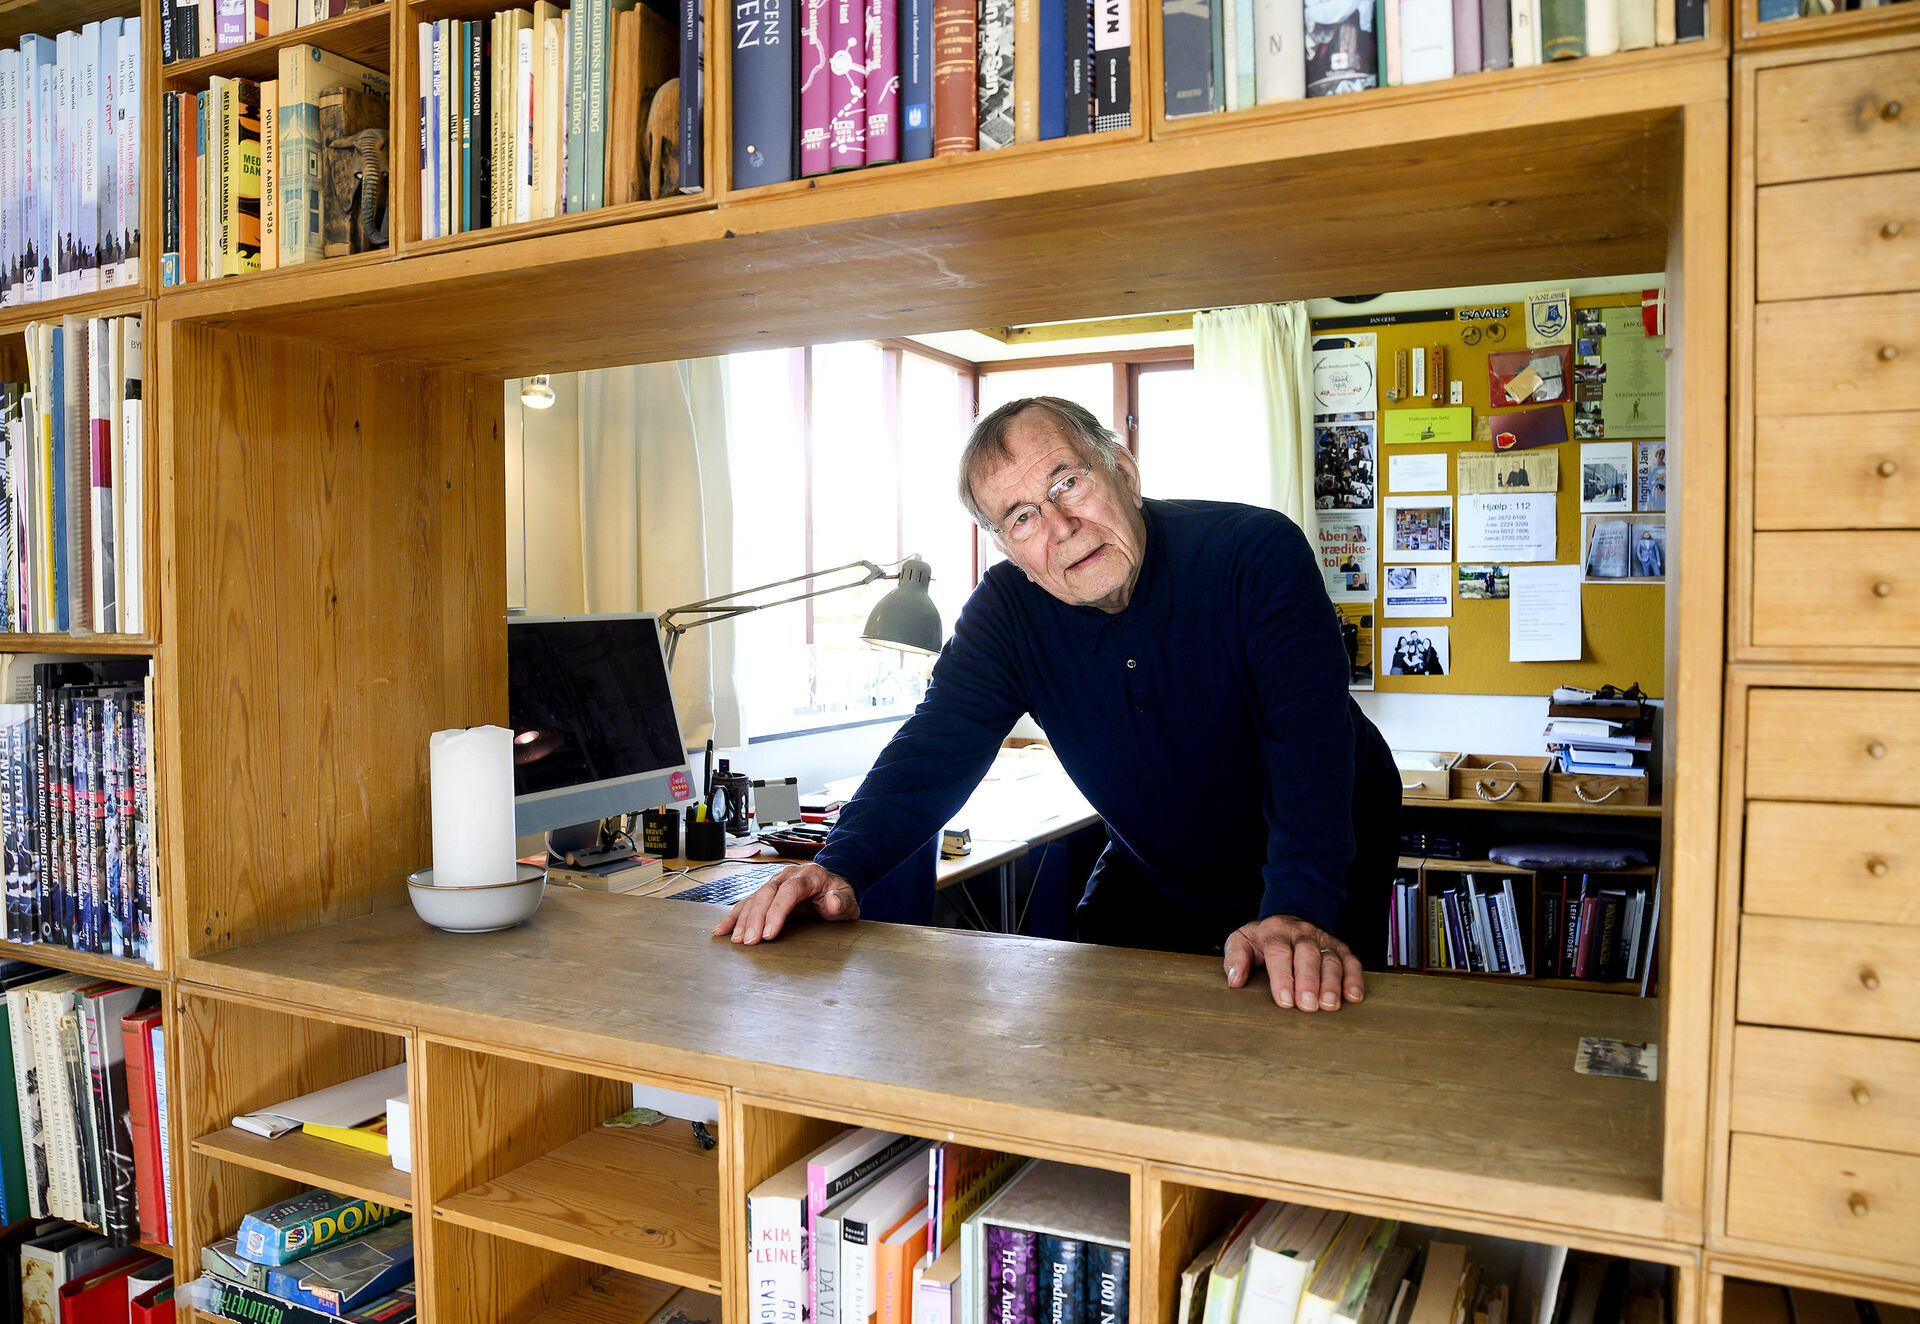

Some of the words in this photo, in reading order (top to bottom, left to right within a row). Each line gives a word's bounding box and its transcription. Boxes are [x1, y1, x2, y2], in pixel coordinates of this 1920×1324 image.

[839, 4, 849, 24] land
[219, 33, 244, 44] Brown
[224, 22, 239, 33] Dan
[128, 53, 136, 69] Jan
[520, 42, 529, 64] art
[86, 63, 94, 78] Jan
[128, 69, 136, 93] Gehl
[984, 55, 1003, 96] Sun
[86, 80, 94, 97] Gel
[223, 91, 231, 111] MED
[571, 74, 583, 135] BILLEDBOG
[590, 71, 601, 133] BILLEDBOG
[85, 118, 94, 155] Gradovi
[222, 113, 230, 173] ARKÆOLOGEN
[86, 157, 93, 167] za
[243, 153, 261, 166] MED
[85, 168, 94, 192] ljude
[127, 162, 135, 196] Kentler
[222, 175, 230, 222] DANMARK
[221, 225, 229, 256] RUNDT
[1458, 307, 1509, 321] SAAB
[1638, 449, 1649, 465] Jan
[1639, 475, 1651, 503] Ingrid
[1482, 503, 1508, 513] Hjælp
[1515, 502, 1531, 510] 112
[12, 726, 21, 761] NEW
[13, 765, 23, 798] CITY
[38, 774, 45, 788] NA
[49, 782, 57, 801] HOW
[2, 792, 11, 835] BYLIV
[14, 802, 23, 835] LIFE
[38, 789, 46, 826] CIDADE:
[50, 801, 57, 813] TO
[40, 826, 48, 854] COMO
[51, 839, 59, 865] PUBLIC
[41, 854, 49, 898] ESTUDAR
[91, 876, 99, 908] RUUMIS
[1569, 904, 1577, 920] LEIF
[1566, 921, 1576, 959] DAVIDSEN
[762, 1228, 791, 1242] KIM
[844, 1232, 865, 1242] Edition
[845, 1226, 864, 1236] Second
[756, 1247, 798, 1265] LEINE
[1002, 1250, 1016, 1285] H.C.
[819, 1268, 834, 1293] DA
[1101, 1272, 1118, 1307] 1001
[312, 1288, 335, 1301] MATCH
[318, 1299, 334, 1309] PLAY
[760, 1279, 776, 1324] EVIG
